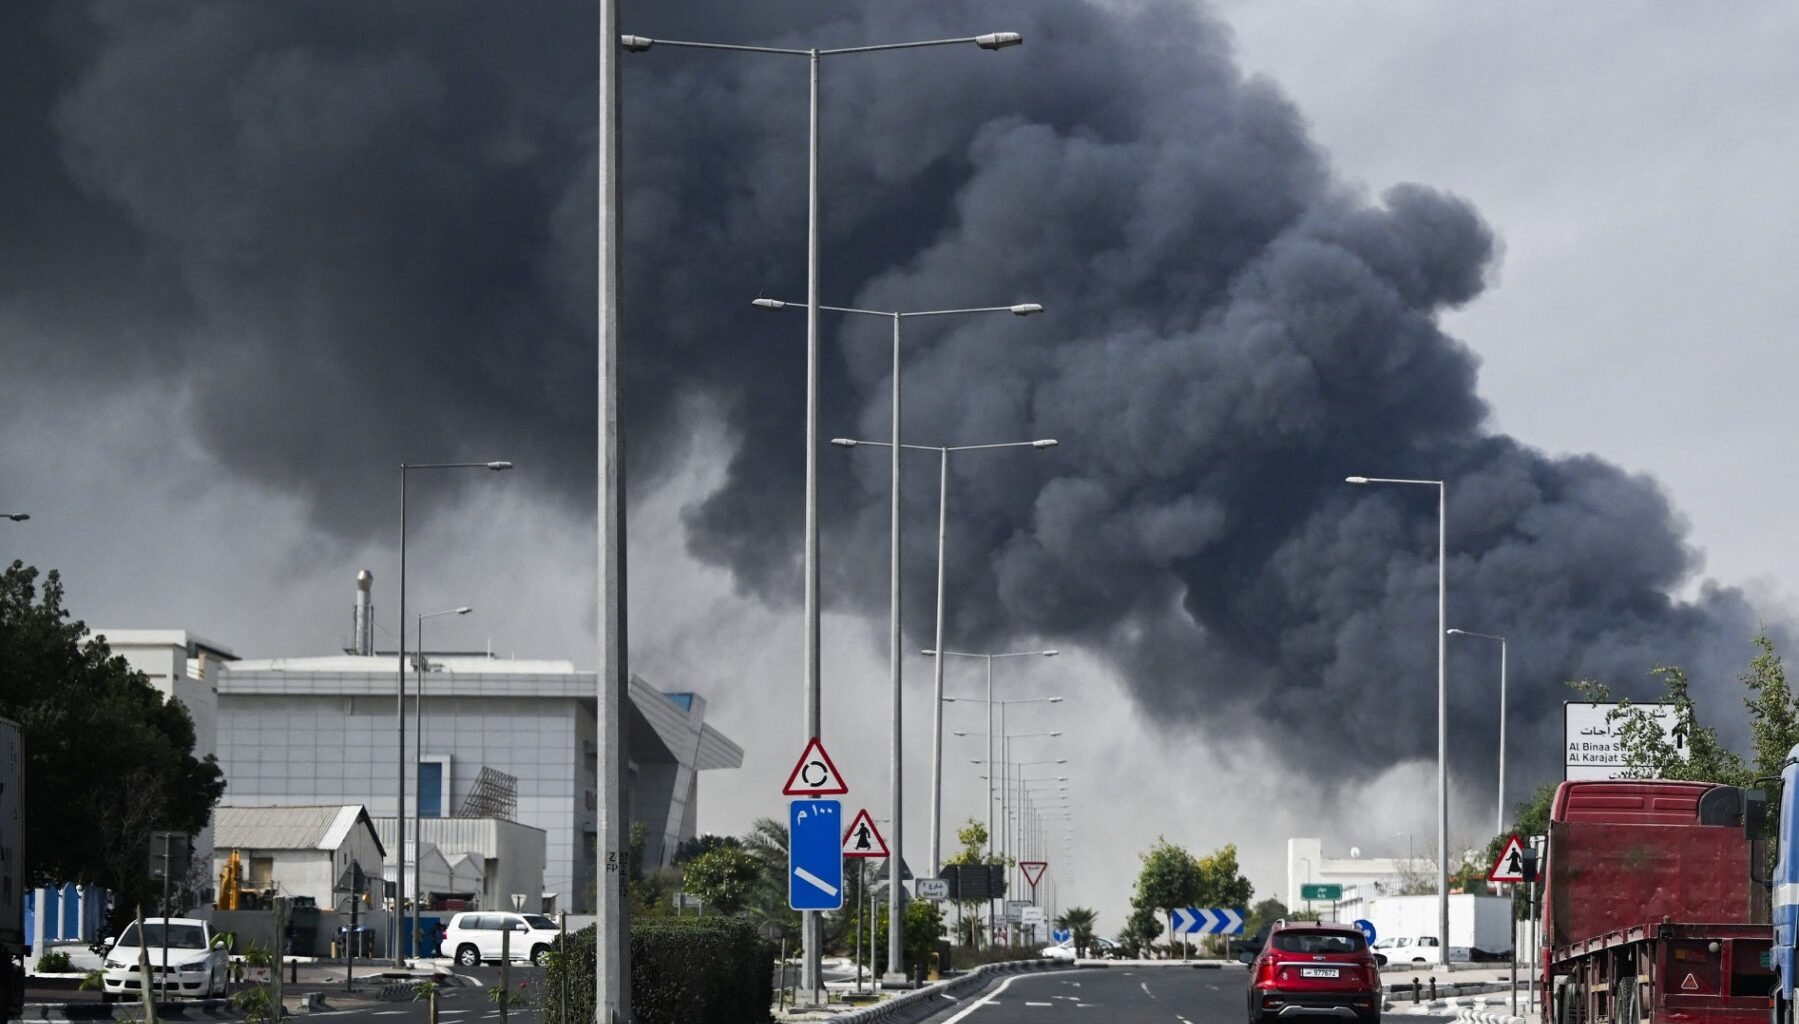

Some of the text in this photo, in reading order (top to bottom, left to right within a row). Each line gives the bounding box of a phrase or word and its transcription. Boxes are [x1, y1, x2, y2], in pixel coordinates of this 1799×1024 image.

[1569, 742, 1579, 751] Al
[1582, 742, 1610, 751] Binaa
[1569, 753, 1579, 762] Al
[1582, 753, 1618, 763] Karajat
[797, 804, 833, 826] ١٠٠ م
[608, 852, 616, 862] Z
